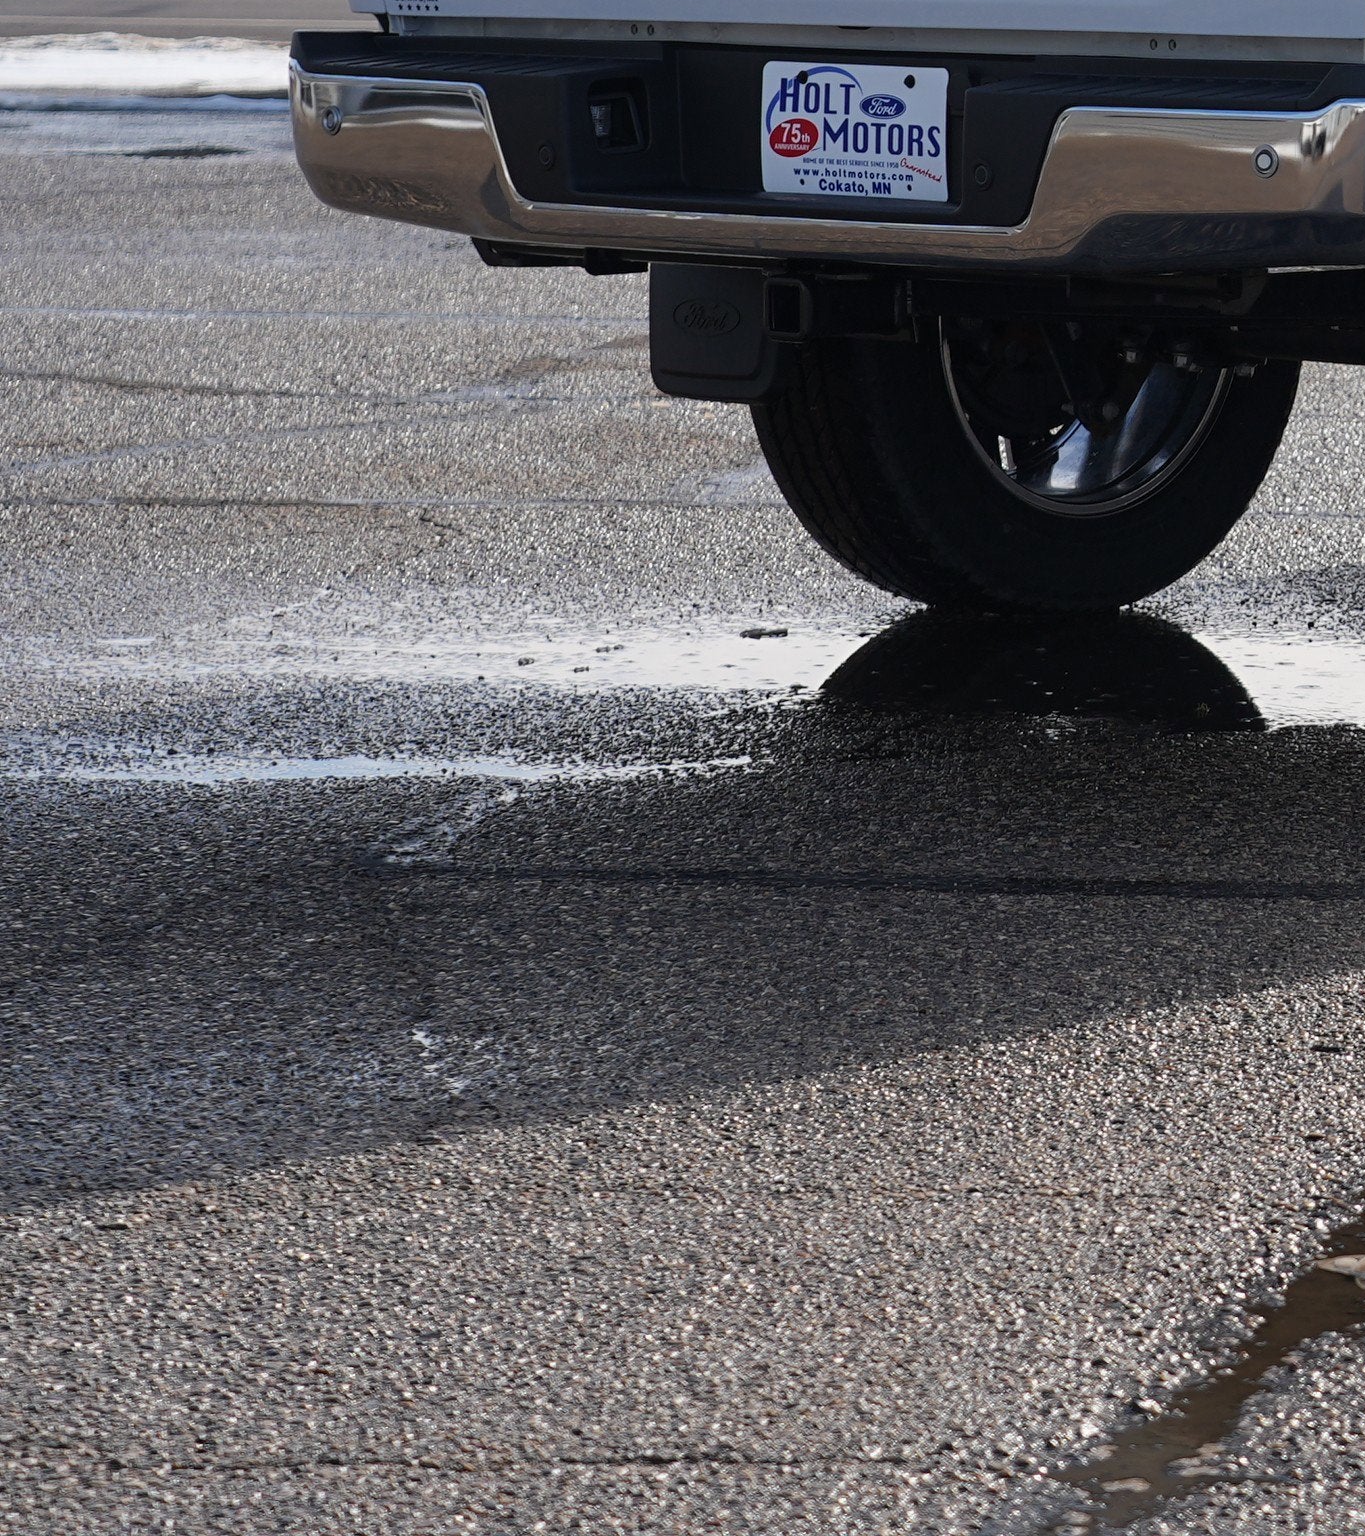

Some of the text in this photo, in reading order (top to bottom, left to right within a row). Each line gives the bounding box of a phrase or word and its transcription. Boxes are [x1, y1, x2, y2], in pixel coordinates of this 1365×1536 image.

[779, 77, 855, 115] HOLT
[868, 97, 898, 115] Ford
[781, 123, 811, 143] 75th
[823, 117, 941, 158] MOTORS
[774, 143, 810, 151] ANNIVERSARY
[794, 168, 914, 182] www.holtmotors.com
[819, 178, 892, 196] Cokato, MN
